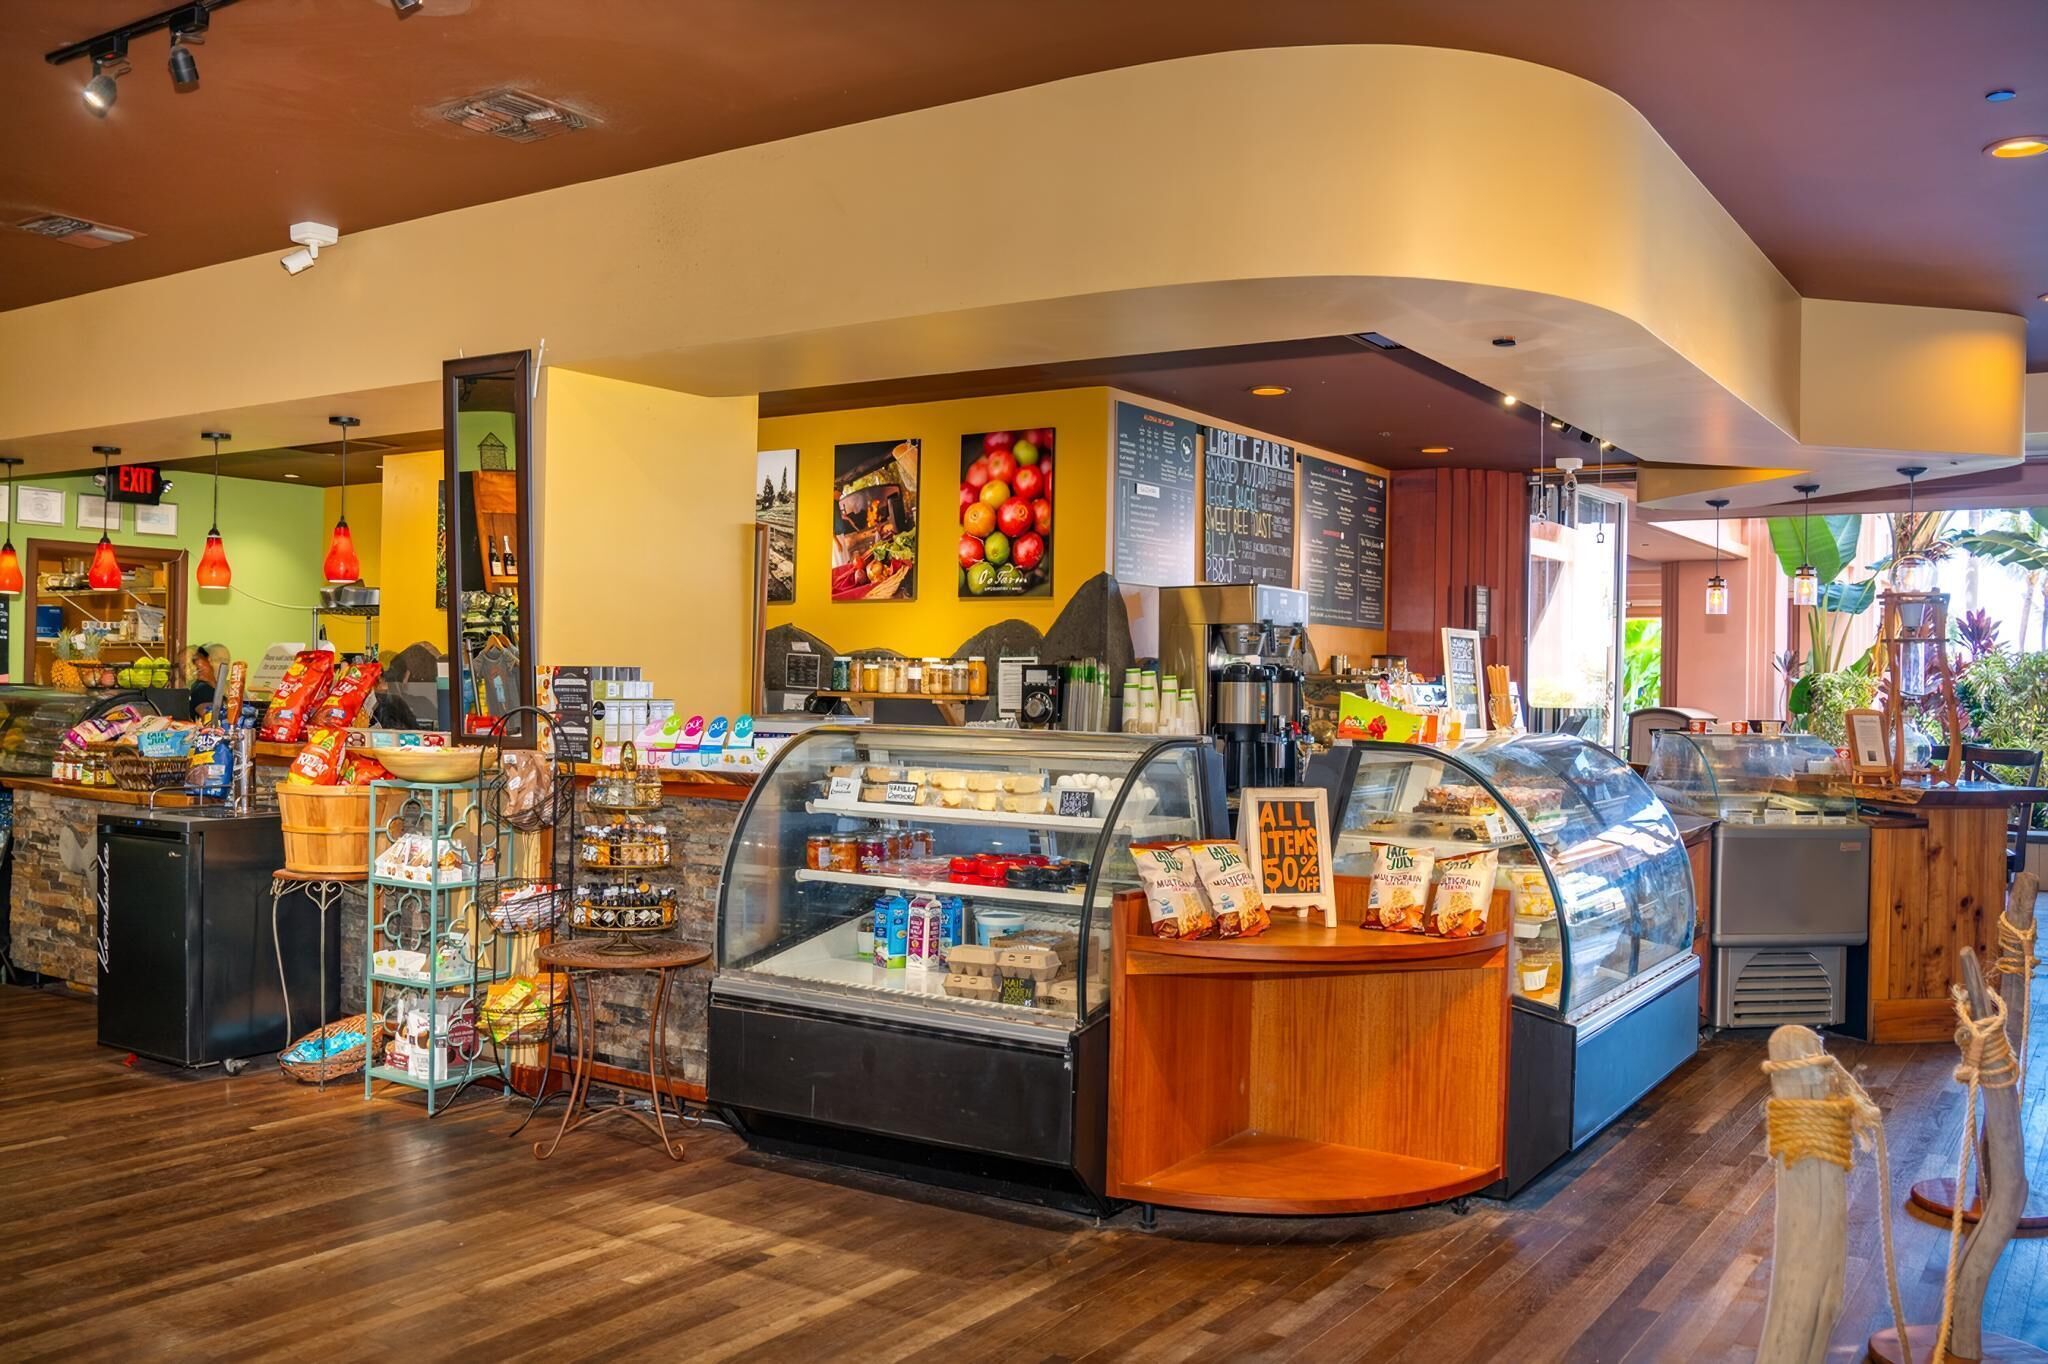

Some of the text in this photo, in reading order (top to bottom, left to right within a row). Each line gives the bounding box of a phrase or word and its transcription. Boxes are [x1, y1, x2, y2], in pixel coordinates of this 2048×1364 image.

[1209, 427, 1247, 459] LIGHT
[1253, 438, 1290, 468] FARE
[120, 465, 154, 493] EXIT
[1205, 504, 1232, 535] SWEET
[1259, 801, 1310, 827] ALL
[1259, 827, 1318, 855] ITEMS
[1386, 845, 1408, 860] LATE
[1262, 856, 1318, 889] 50%
[1387, 856, 1413, 870] JULY
[1297, 876, 1320, 891] OFF
[1373, 873, 1422, 883] MULTIGRAIN
